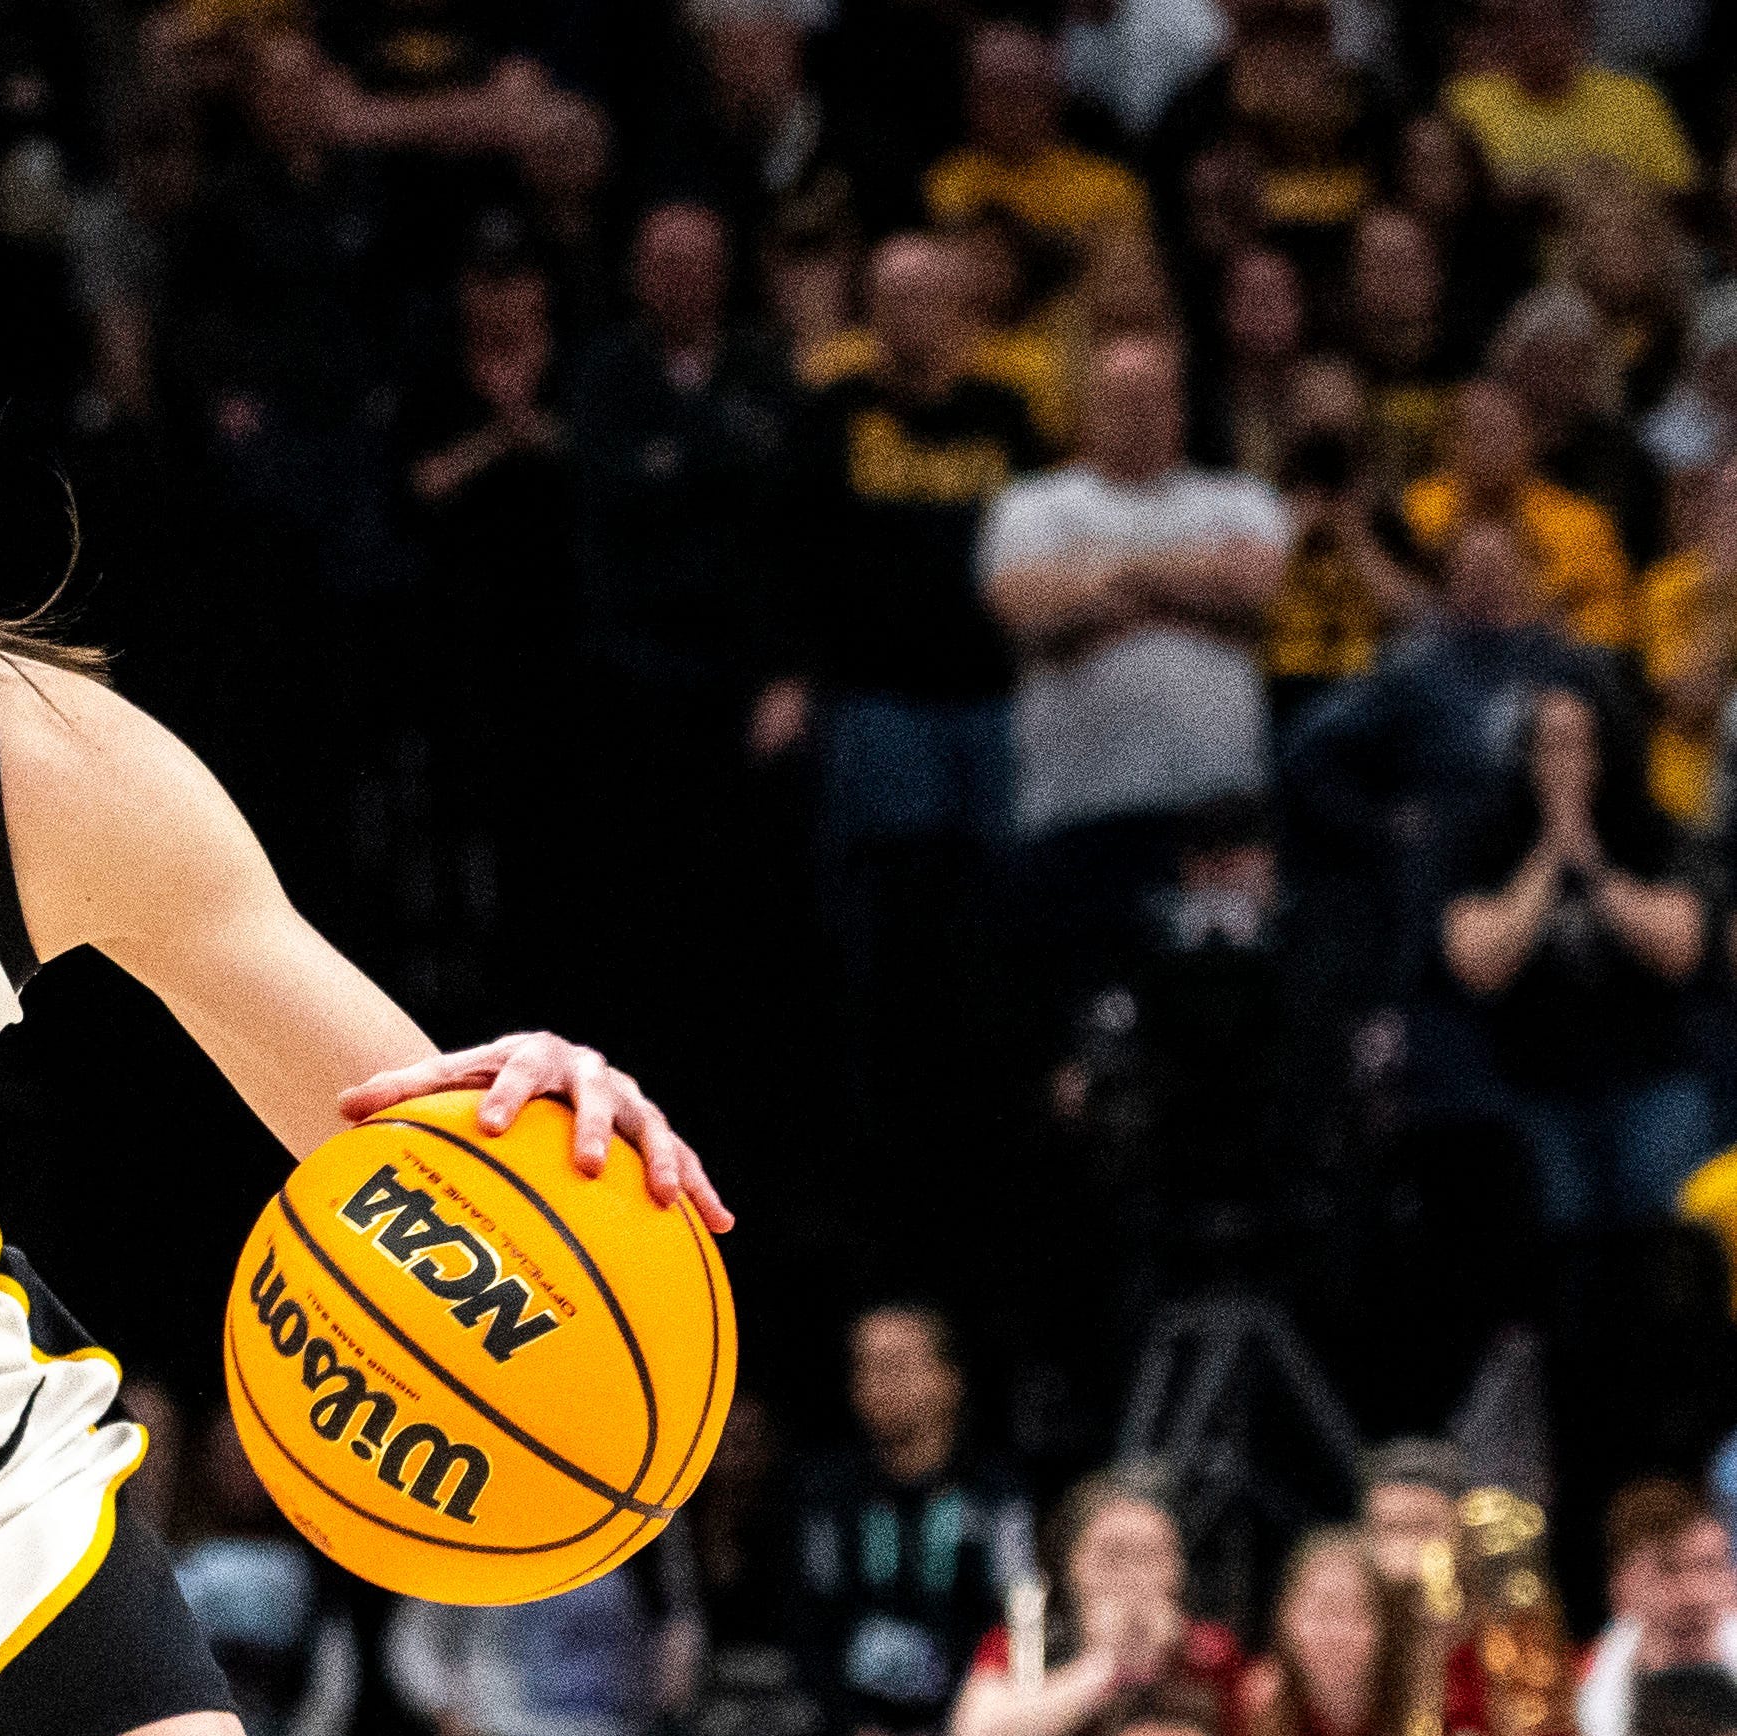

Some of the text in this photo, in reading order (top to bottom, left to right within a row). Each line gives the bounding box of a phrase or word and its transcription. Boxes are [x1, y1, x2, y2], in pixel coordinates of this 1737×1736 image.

[335, 1163, 562, 1366] NCAA
[402, 1149, 578, 1318] OFFICIAL GAME BALL
[250, 1245, 494, 1526] Wilson
